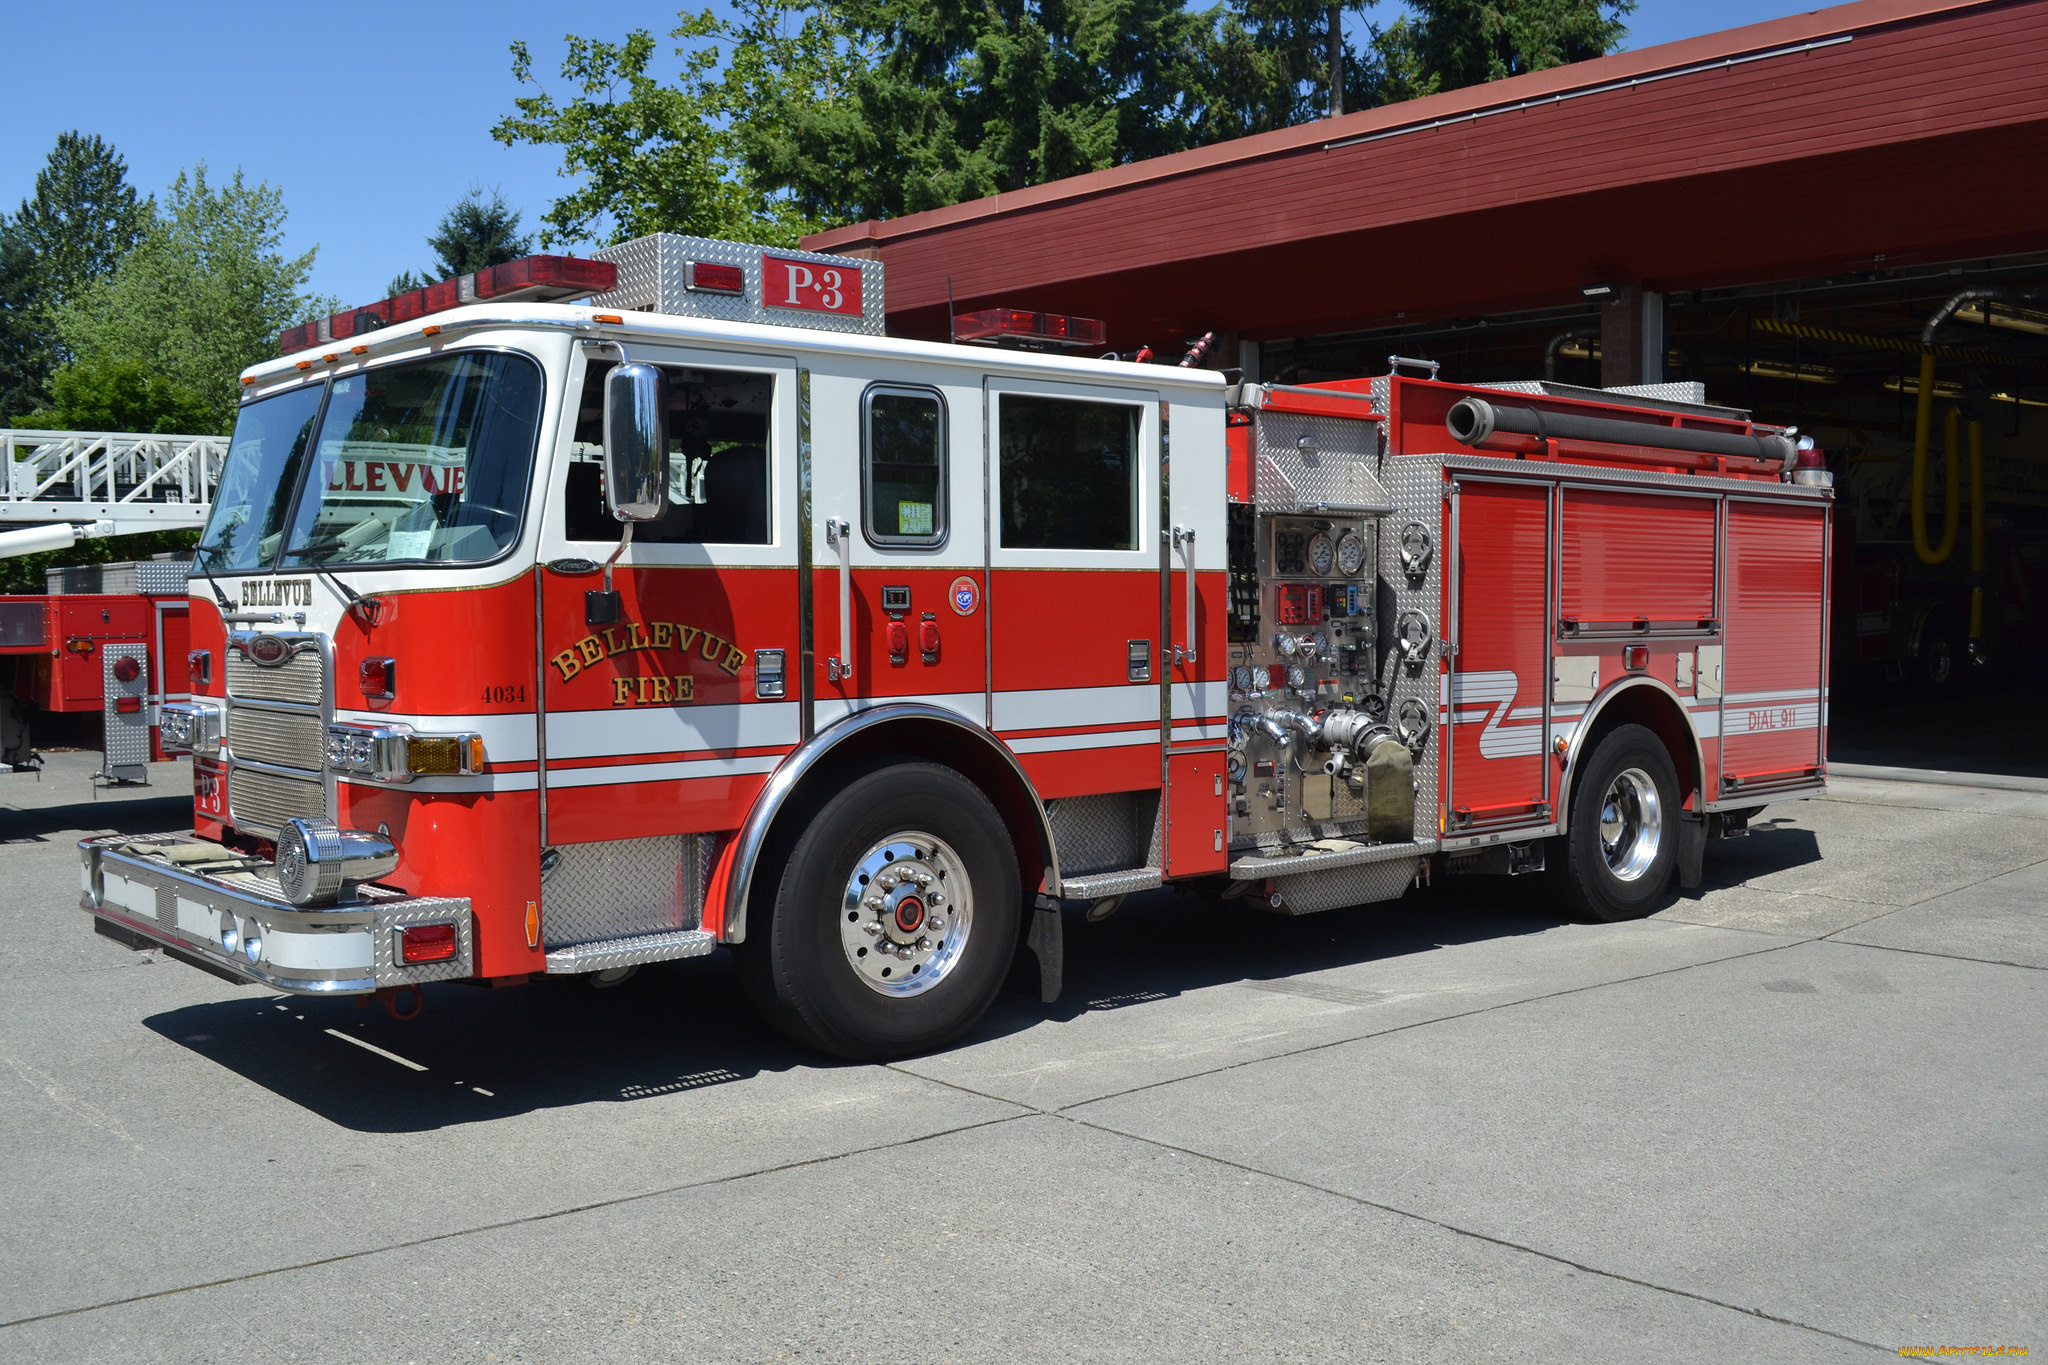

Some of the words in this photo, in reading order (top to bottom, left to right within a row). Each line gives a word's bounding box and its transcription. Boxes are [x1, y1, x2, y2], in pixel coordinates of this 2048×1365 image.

[242, 579, 312, 606] BELLEVUE
[551, 621, 748, 684] BELLEVUE
[481, 685, 526, 704] 4034
[612, 675, 694, 706] FIRE
[1749, 710, 1776, 730] DIAL
[1781, 708, 1796, 727] 911
